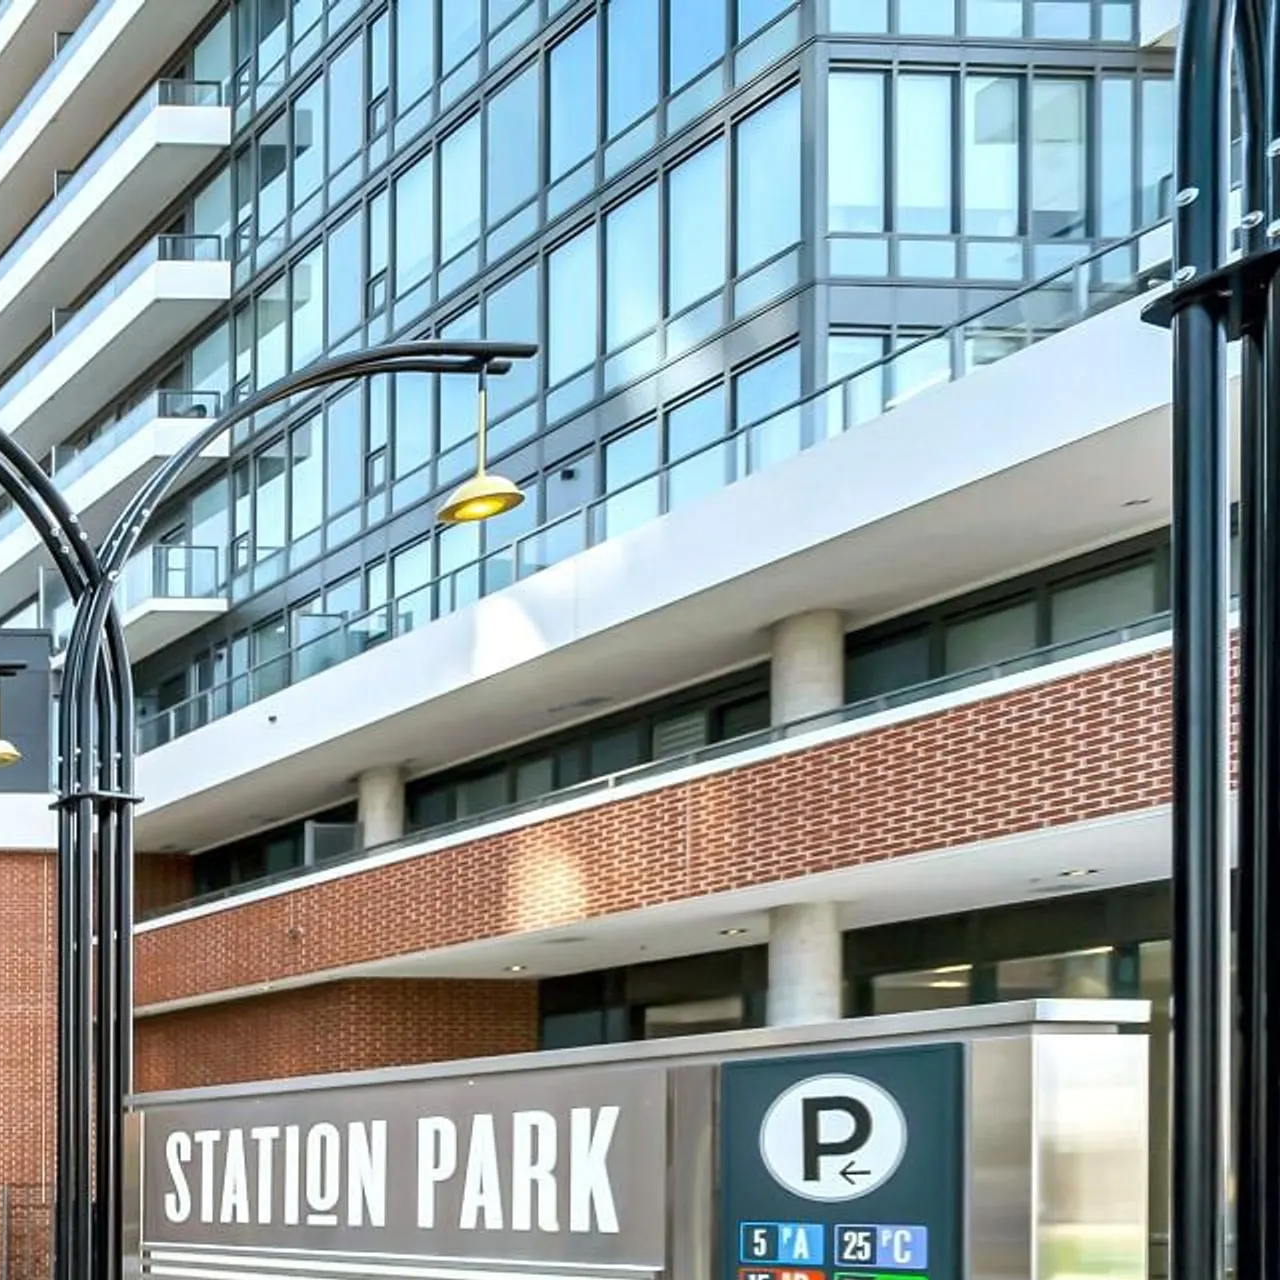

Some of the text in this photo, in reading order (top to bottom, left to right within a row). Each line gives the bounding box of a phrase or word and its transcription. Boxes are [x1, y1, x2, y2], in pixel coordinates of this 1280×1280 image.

[801, 1095, 873, 1182] P
[163, 1105, 621, 1234] STATION PARK
[752, 1228, 768, 1257] 5
[842, 1231, 872, 1262] 25
